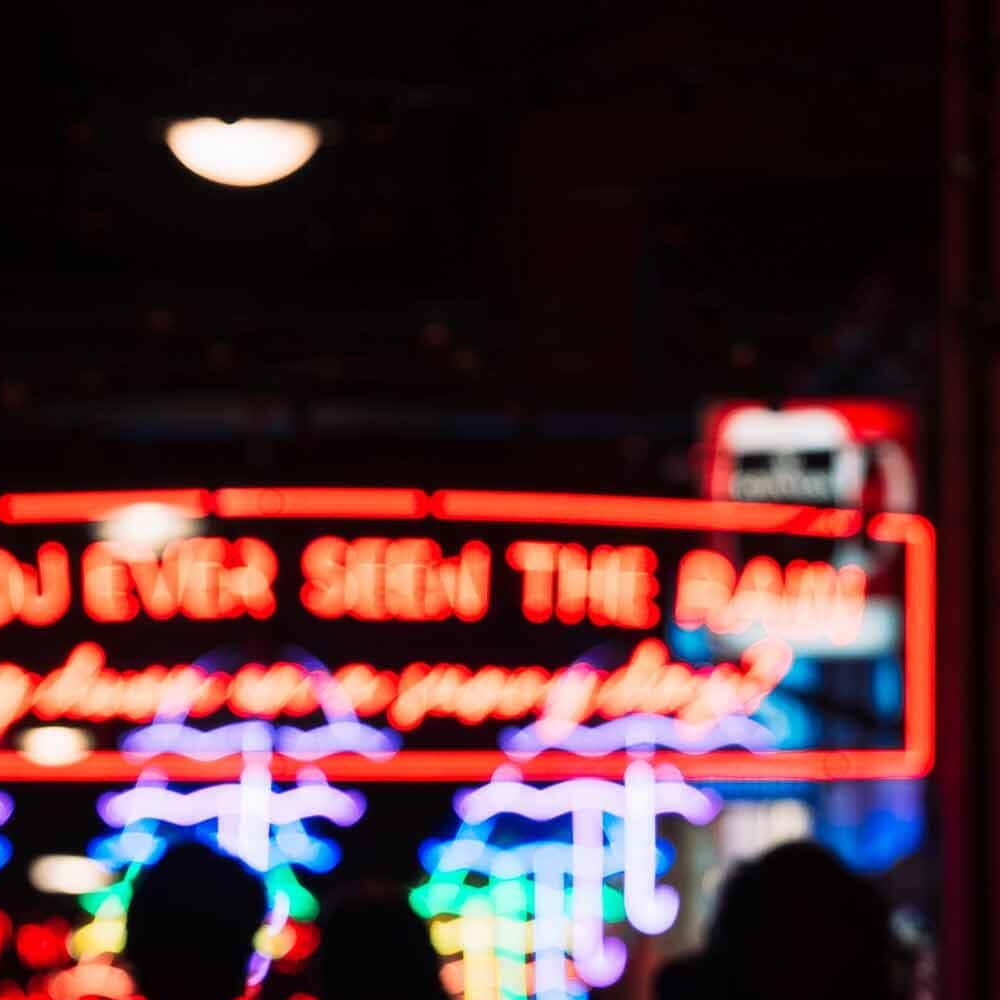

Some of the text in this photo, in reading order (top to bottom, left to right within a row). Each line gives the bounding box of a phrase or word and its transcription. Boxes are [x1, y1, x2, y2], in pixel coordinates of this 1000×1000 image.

[81, 536, 278, 623] EVER
[299, 536, 491, 622] SEEN
[505, 541, 661, 628] THE
[675, 549, 868, 645] RAIN
